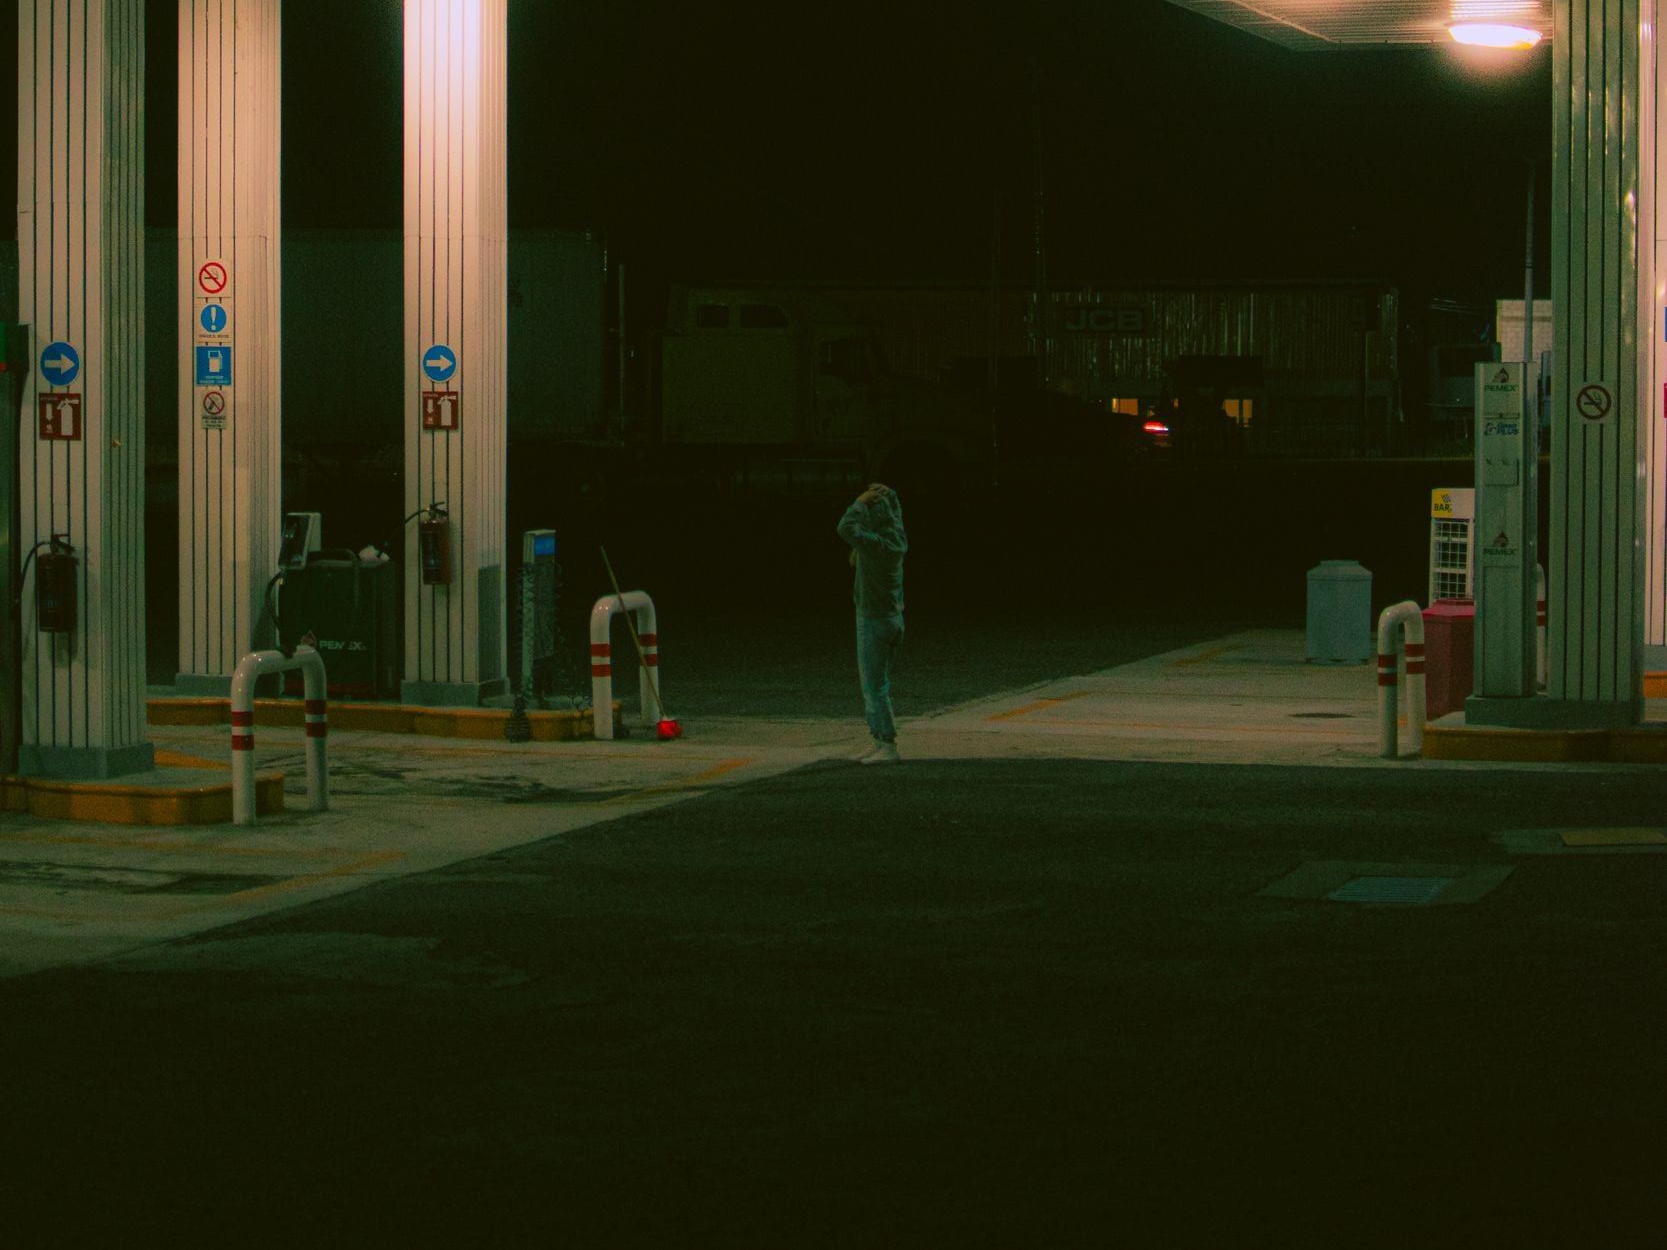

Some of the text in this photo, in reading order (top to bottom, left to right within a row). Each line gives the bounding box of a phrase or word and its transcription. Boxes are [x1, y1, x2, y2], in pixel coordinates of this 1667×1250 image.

[1064, 309, 1145, 332] JCB
[1484, 384, 1517, 392] PEMEX
[1483, 548, 1516, 556] PEMEX
